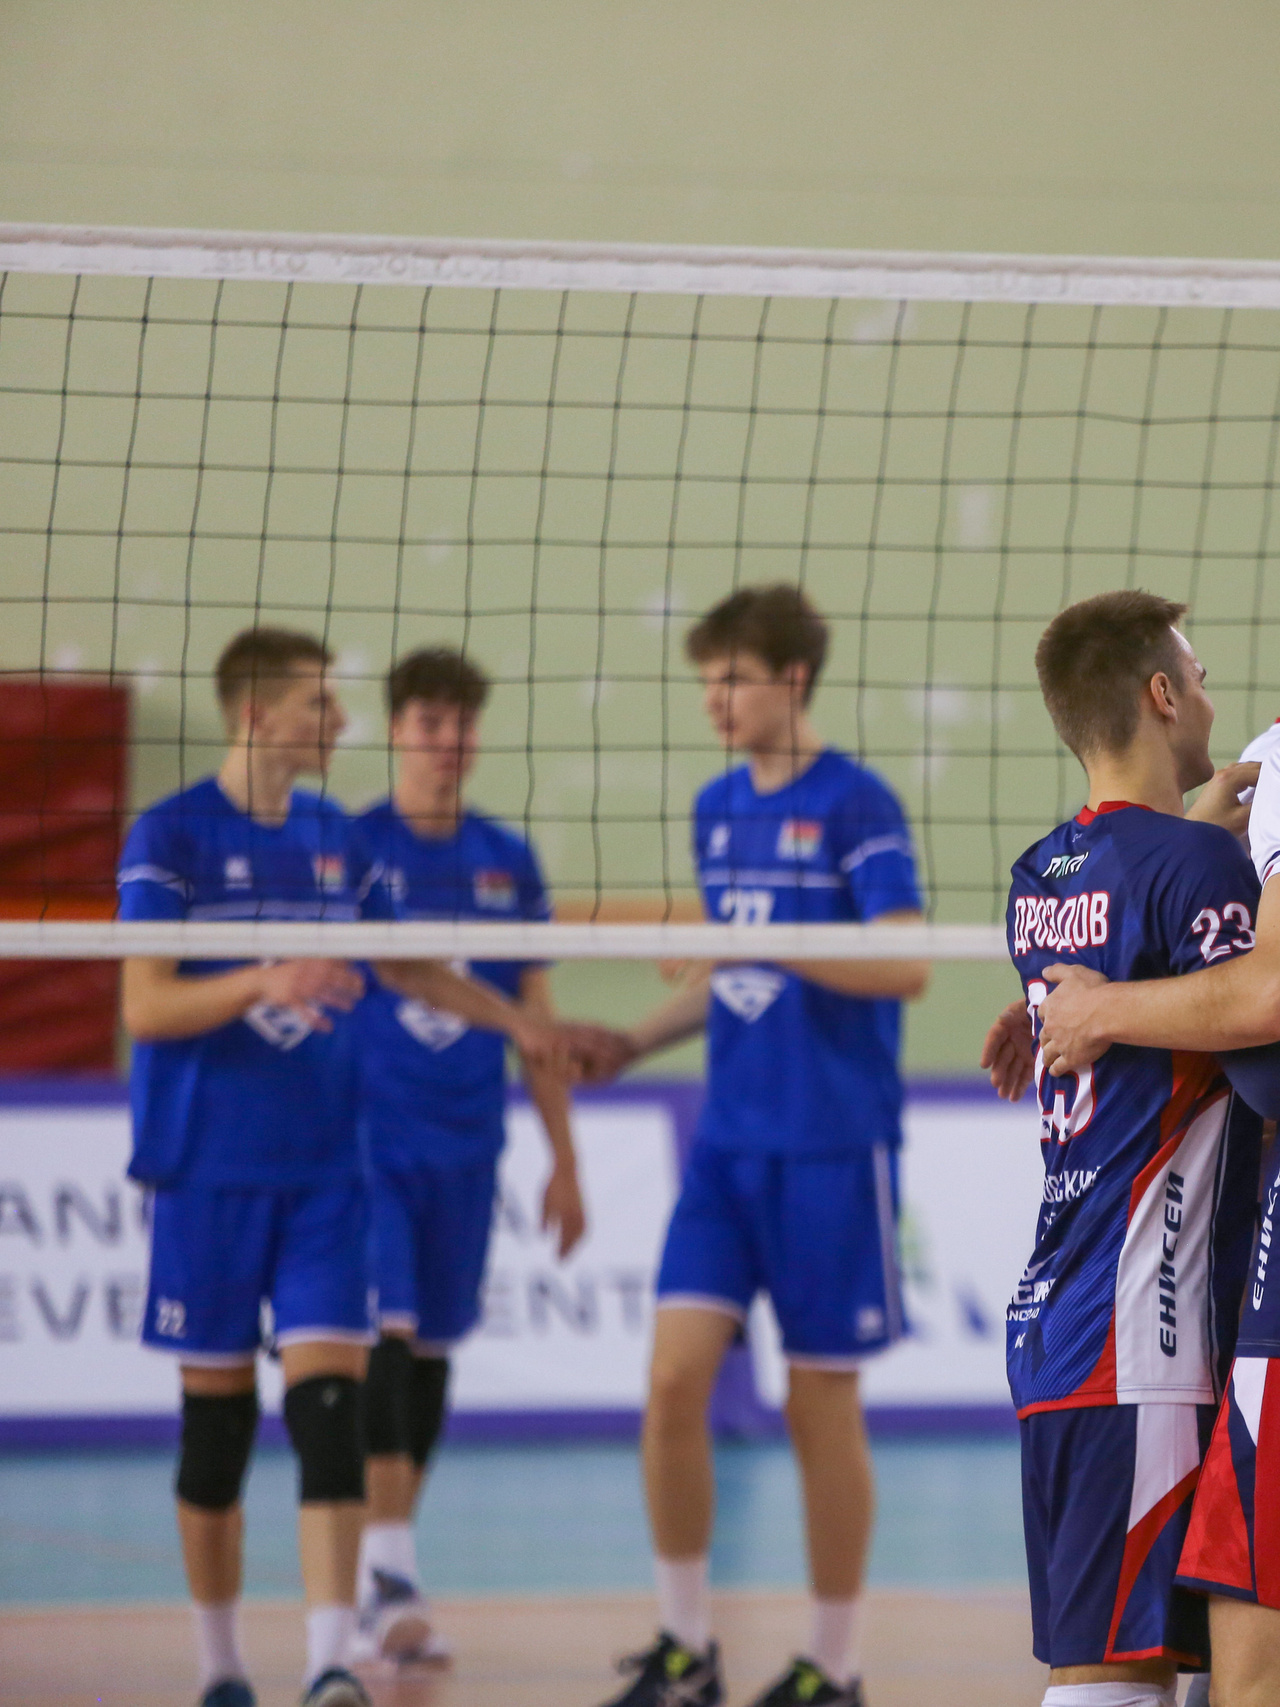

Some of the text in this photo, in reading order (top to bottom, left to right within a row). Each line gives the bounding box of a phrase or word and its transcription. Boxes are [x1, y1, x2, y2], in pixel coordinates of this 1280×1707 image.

[1014, 890, 1110, 956] ДРОЗДОВ
[1191, 901, 1257, 963] 23
[1159, 1171, 1185, 1358] ЕНИСЕЙ
